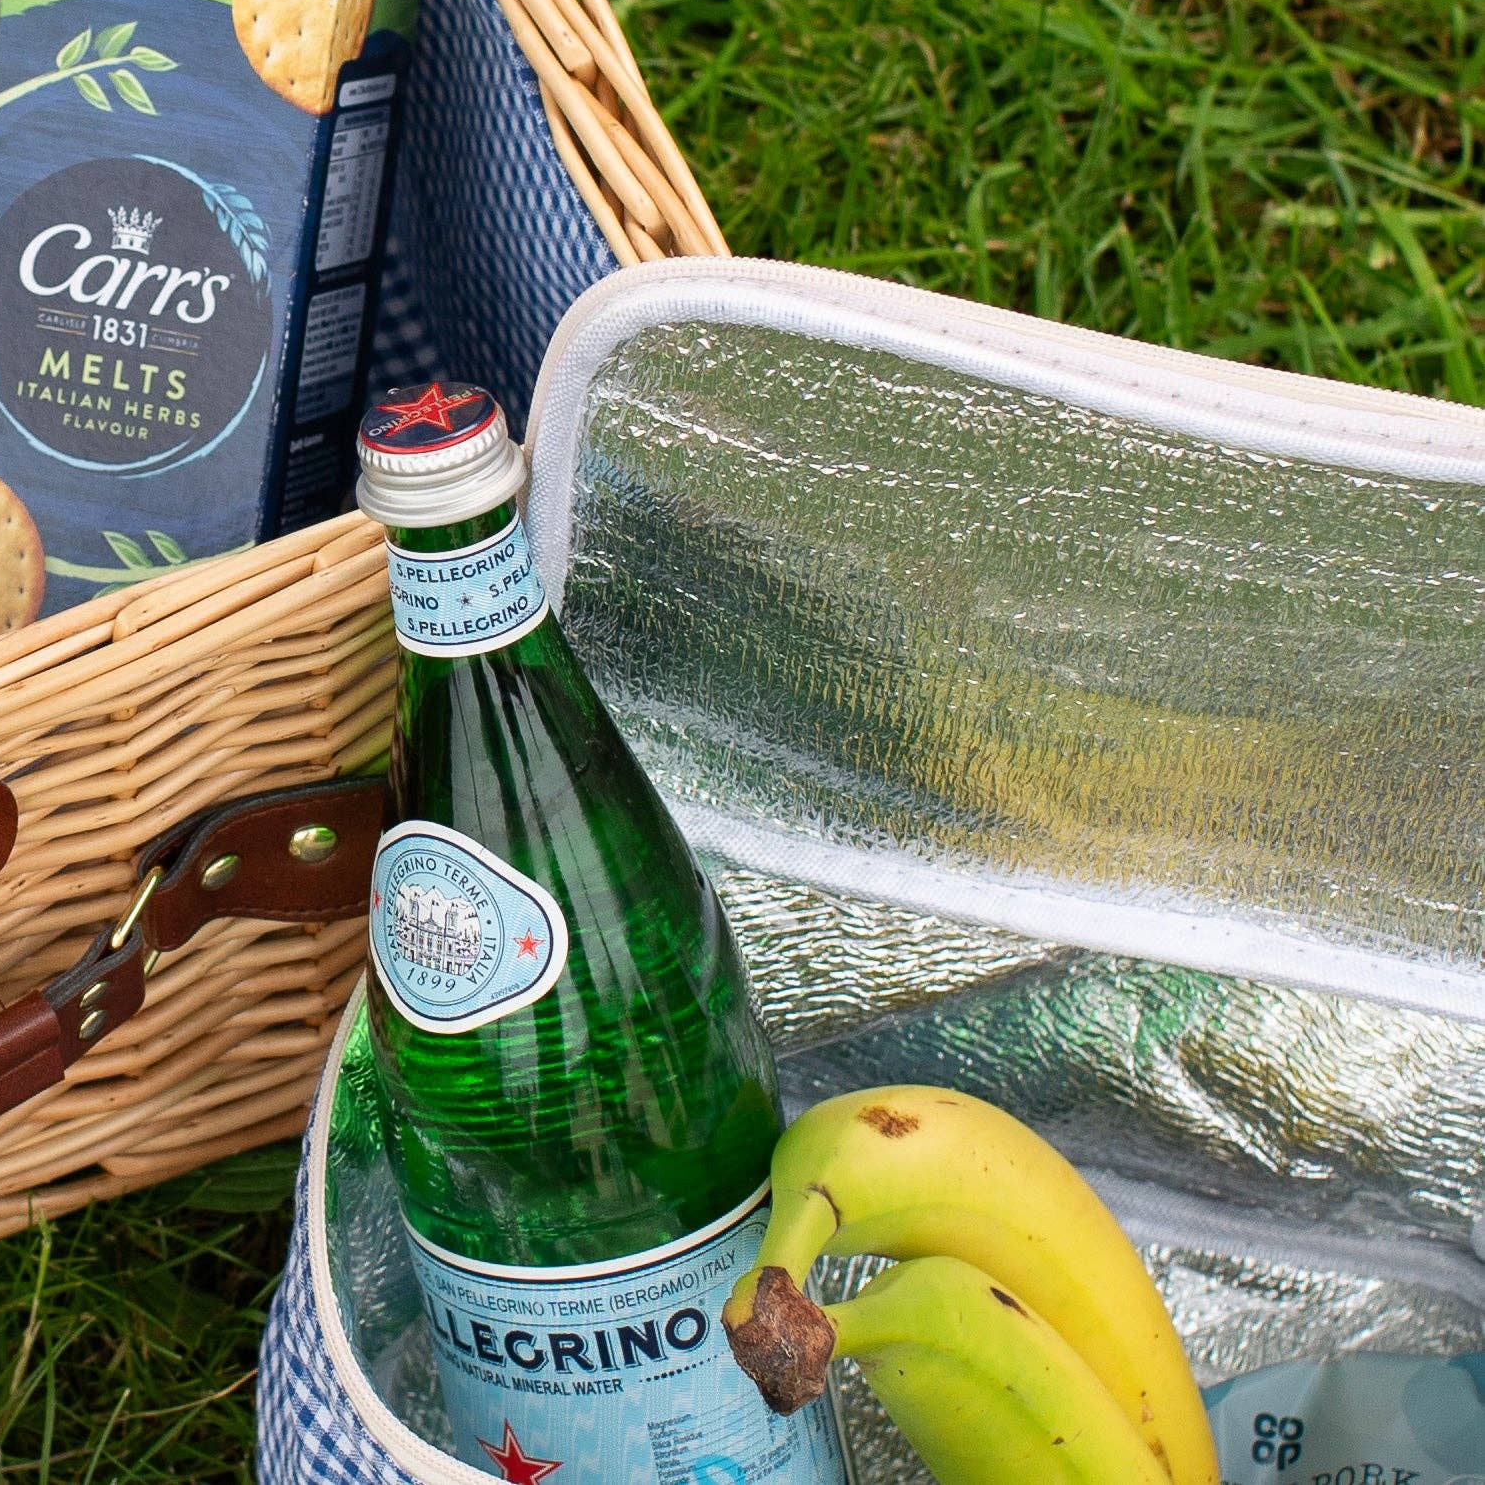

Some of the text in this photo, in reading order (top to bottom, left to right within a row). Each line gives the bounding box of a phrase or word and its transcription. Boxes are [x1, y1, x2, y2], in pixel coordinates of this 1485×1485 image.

[19, 223, 230, 324] Carr's
[93, 314, 148, 349] 1831
[39, 347, 186, 400] MELTS
[17, 381, 201, 428] ITALIAN HERBS
[63, 414, 149, 440] FLAVOUR
[396, 543, 515, 583] S.PELLEGRINO
[407, 595, 529, 637] S.PELLEGRINO
[386, 856, 498, 986] SAN PELLEGRINO TERME ITALIA
[406, 967, 457, 993] 1899
[457, 1288, 545, 1317] PELLEGRINO
[548, 1298, 605, 1317] TERME
[609, 1273, 701, 1313] (BERGAMO)
[701, 1250, 737, 1287] ITALY
[460, 1359, 625, 1395] NATURAL MINERAL WATER
